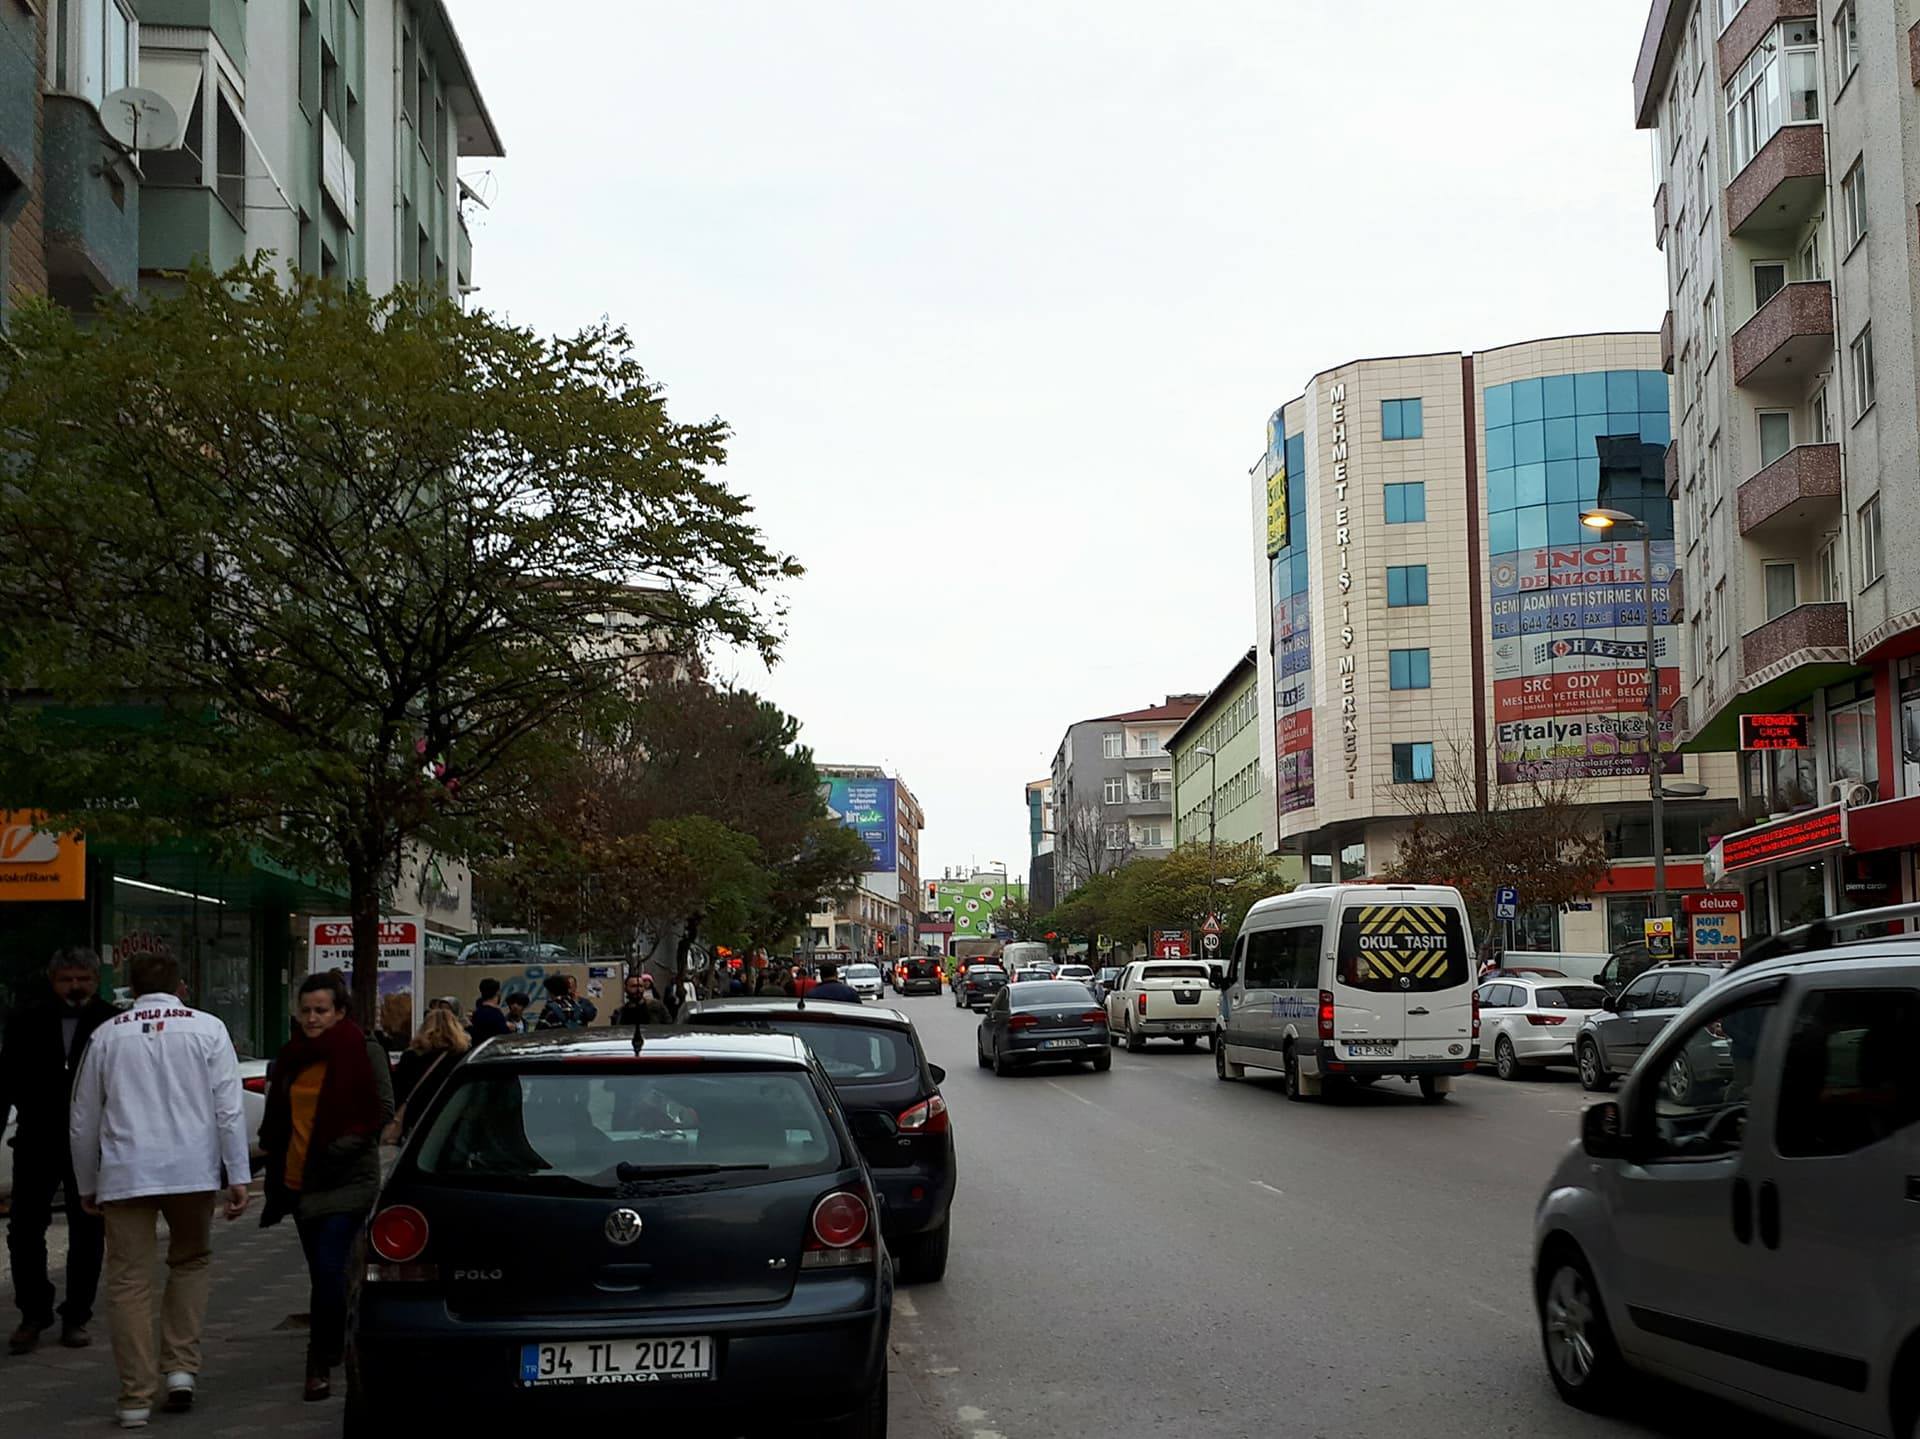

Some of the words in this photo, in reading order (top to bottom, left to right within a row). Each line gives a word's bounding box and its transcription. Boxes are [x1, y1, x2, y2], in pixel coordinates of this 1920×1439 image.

[1330, 384, 1349, 501] MEHMET
[1534, 543, 1628, 570] İNCİ
[1520, 566, 1643, 590] DENİZCİLİK
[1522, 615, 1541, 632] 644
[1563, 612, 1577, 627] 52
[1621, 609, 1640, 624] 644
[1524, 679, 1552, 693] SRC
[1567, 674, 1600, 688] ODY
[1617, 670, 1649, 686] ÜDY
[1502, 694, 1545, 707] MESLEKİ
[1553, 686, 1612, 701] YETERLİLİK
[1500, 721, 1582, 743] Eftalya
[1586, 720, 1628, 734] Estetik
[1502, 891, 1513, 903] P
[1700, 898, 1738, 909] deluxe
[1206, 937, 1217, 946] 30
[1359, 936, 1398, 949] OKUL
[1407, 935, 1447, 951] TAŞITI
[1163, 946, 1180, 959] 15
[134, 1009, 161, 1021] POLO
[454, 1269, 503, 1281] POLO
[541, 1347, 573, 1375] 34
[587, 1344, 620, 1373] TL
[635, 1340, 701, 1371] 2021
[525, 1365, 537, 1374] TR
[586, 1373, 660, 1385] KARACA
